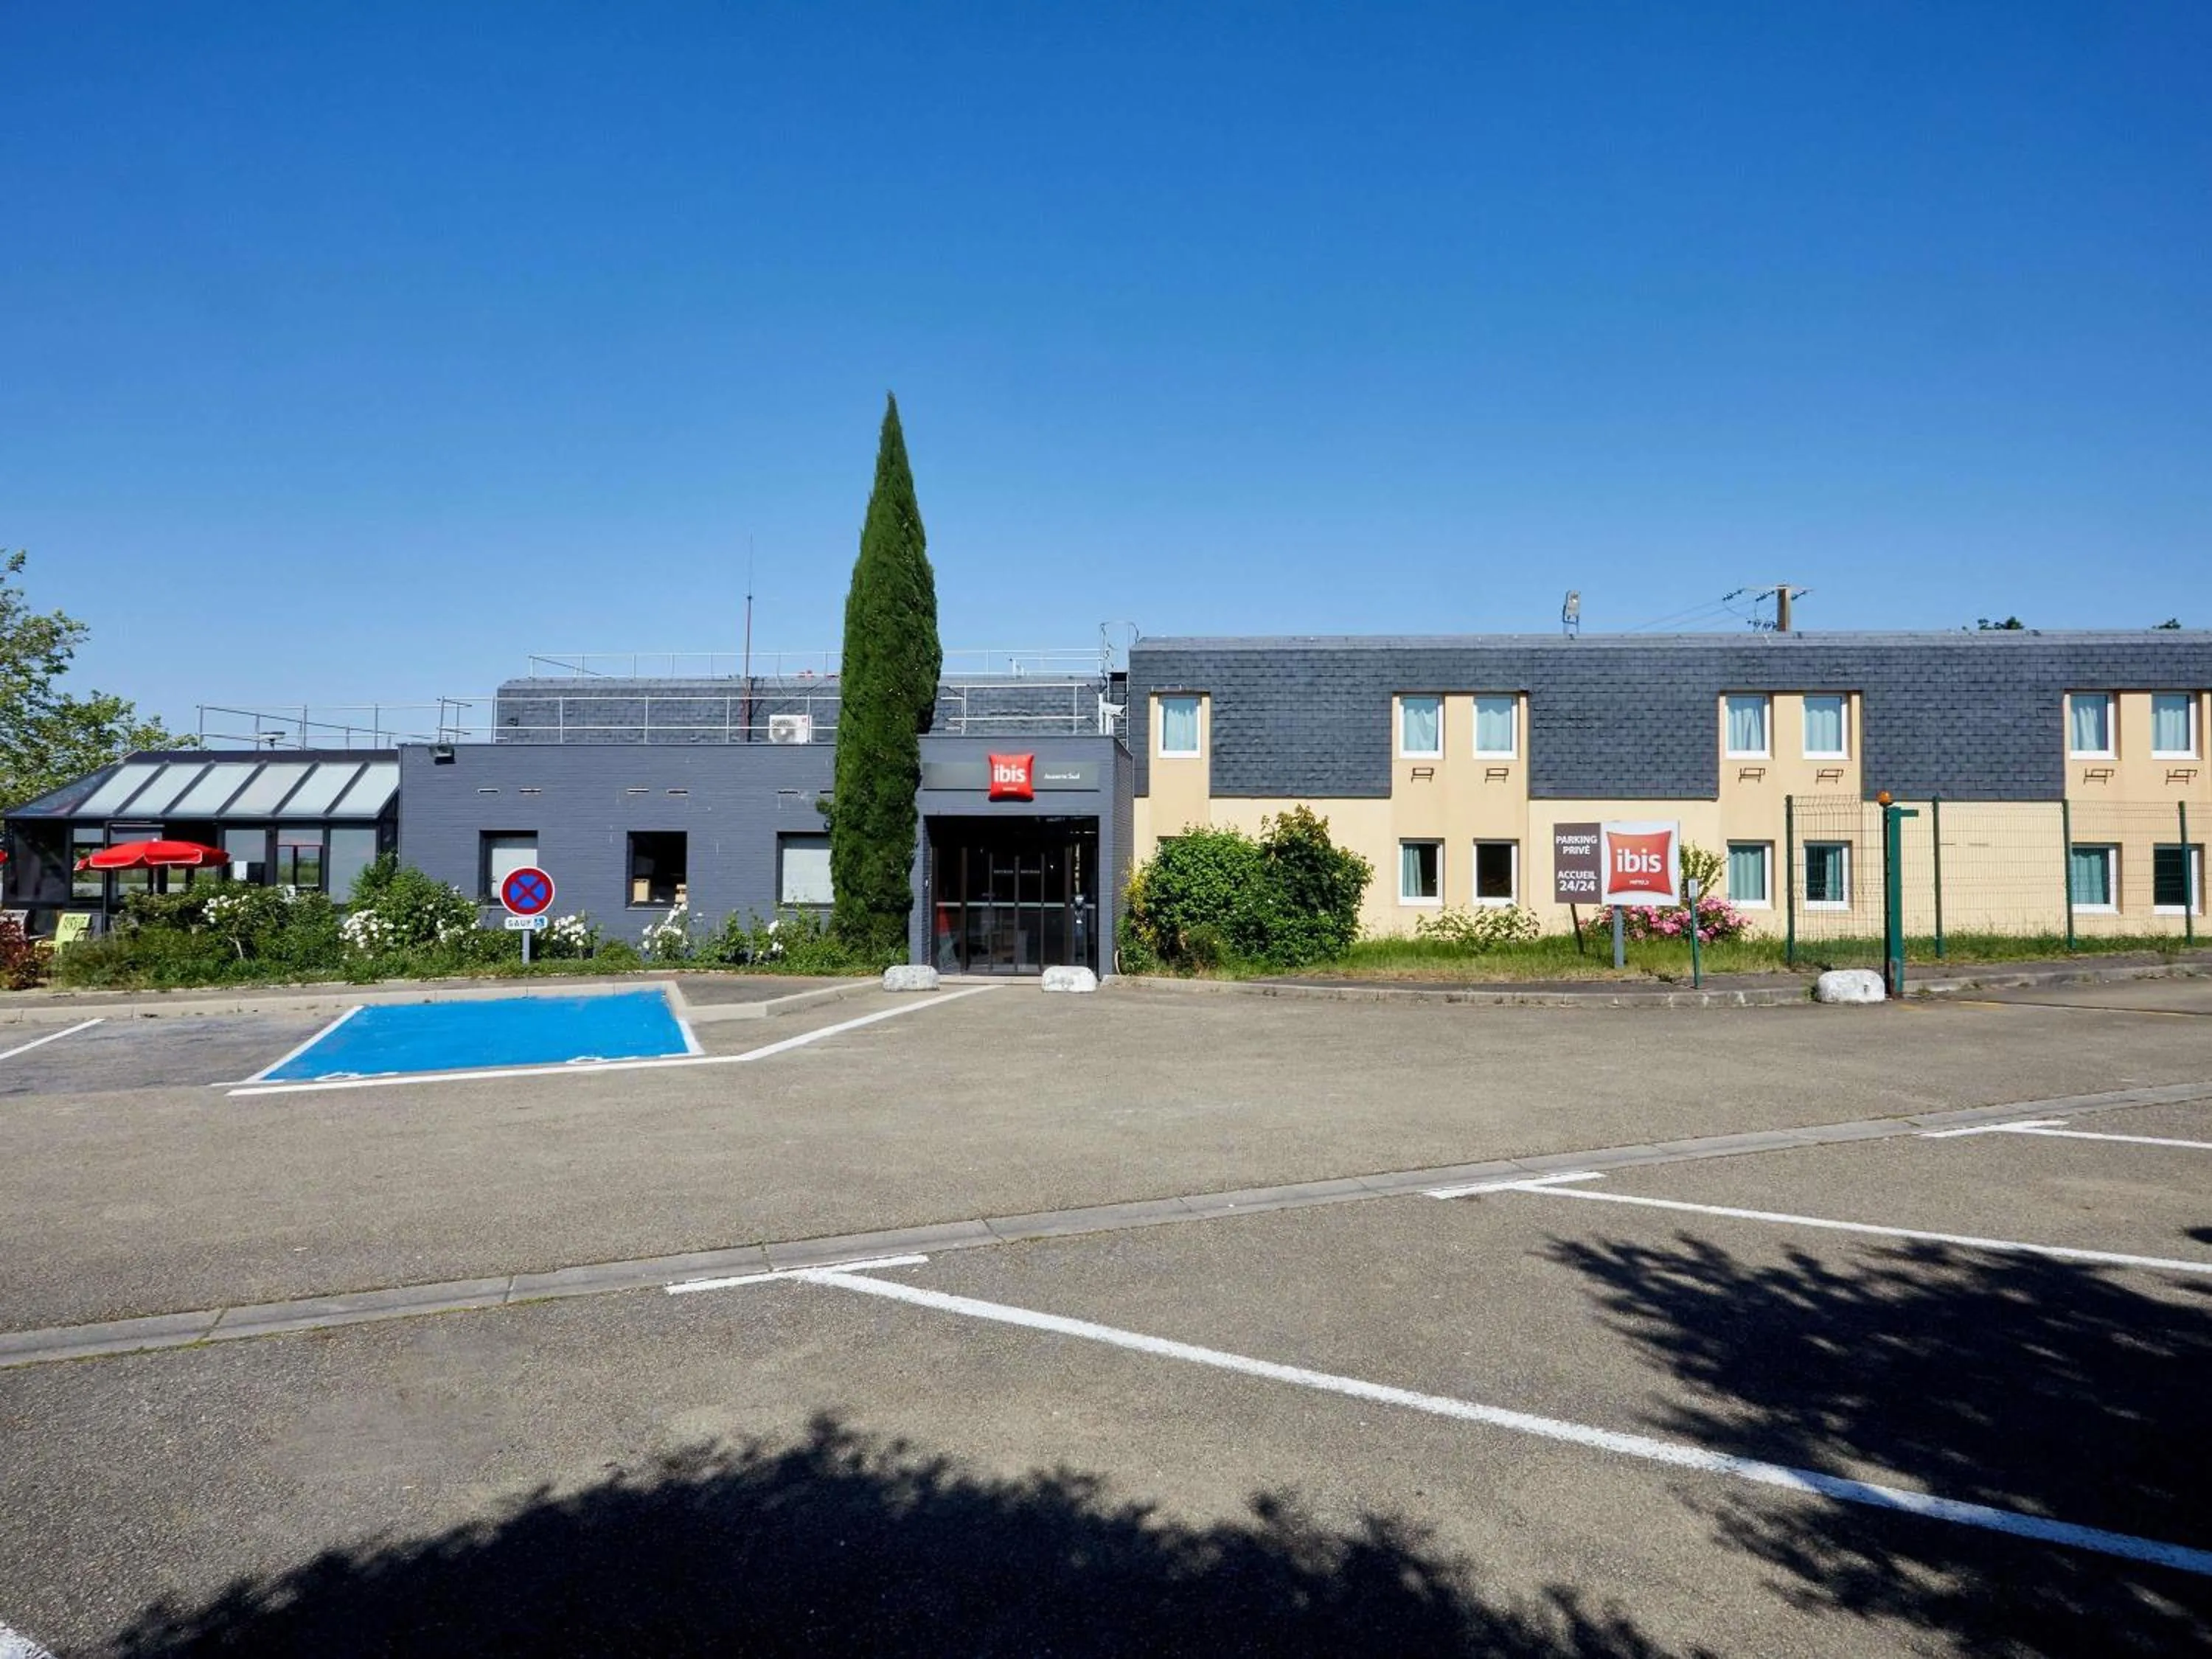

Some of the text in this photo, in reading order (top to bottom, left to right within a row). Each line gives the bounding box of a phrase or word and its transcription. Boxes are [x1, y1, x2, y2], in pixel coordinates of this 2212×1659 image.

[993, 763, 1027, 783] ibis
[1556, 835, 1598, 844] PARKING
[1616, 848, 1662, 873] ibis
[1557, 870, 1598, 880] ACCUEIL
[1559, 880, 1596, 891] 24/24
